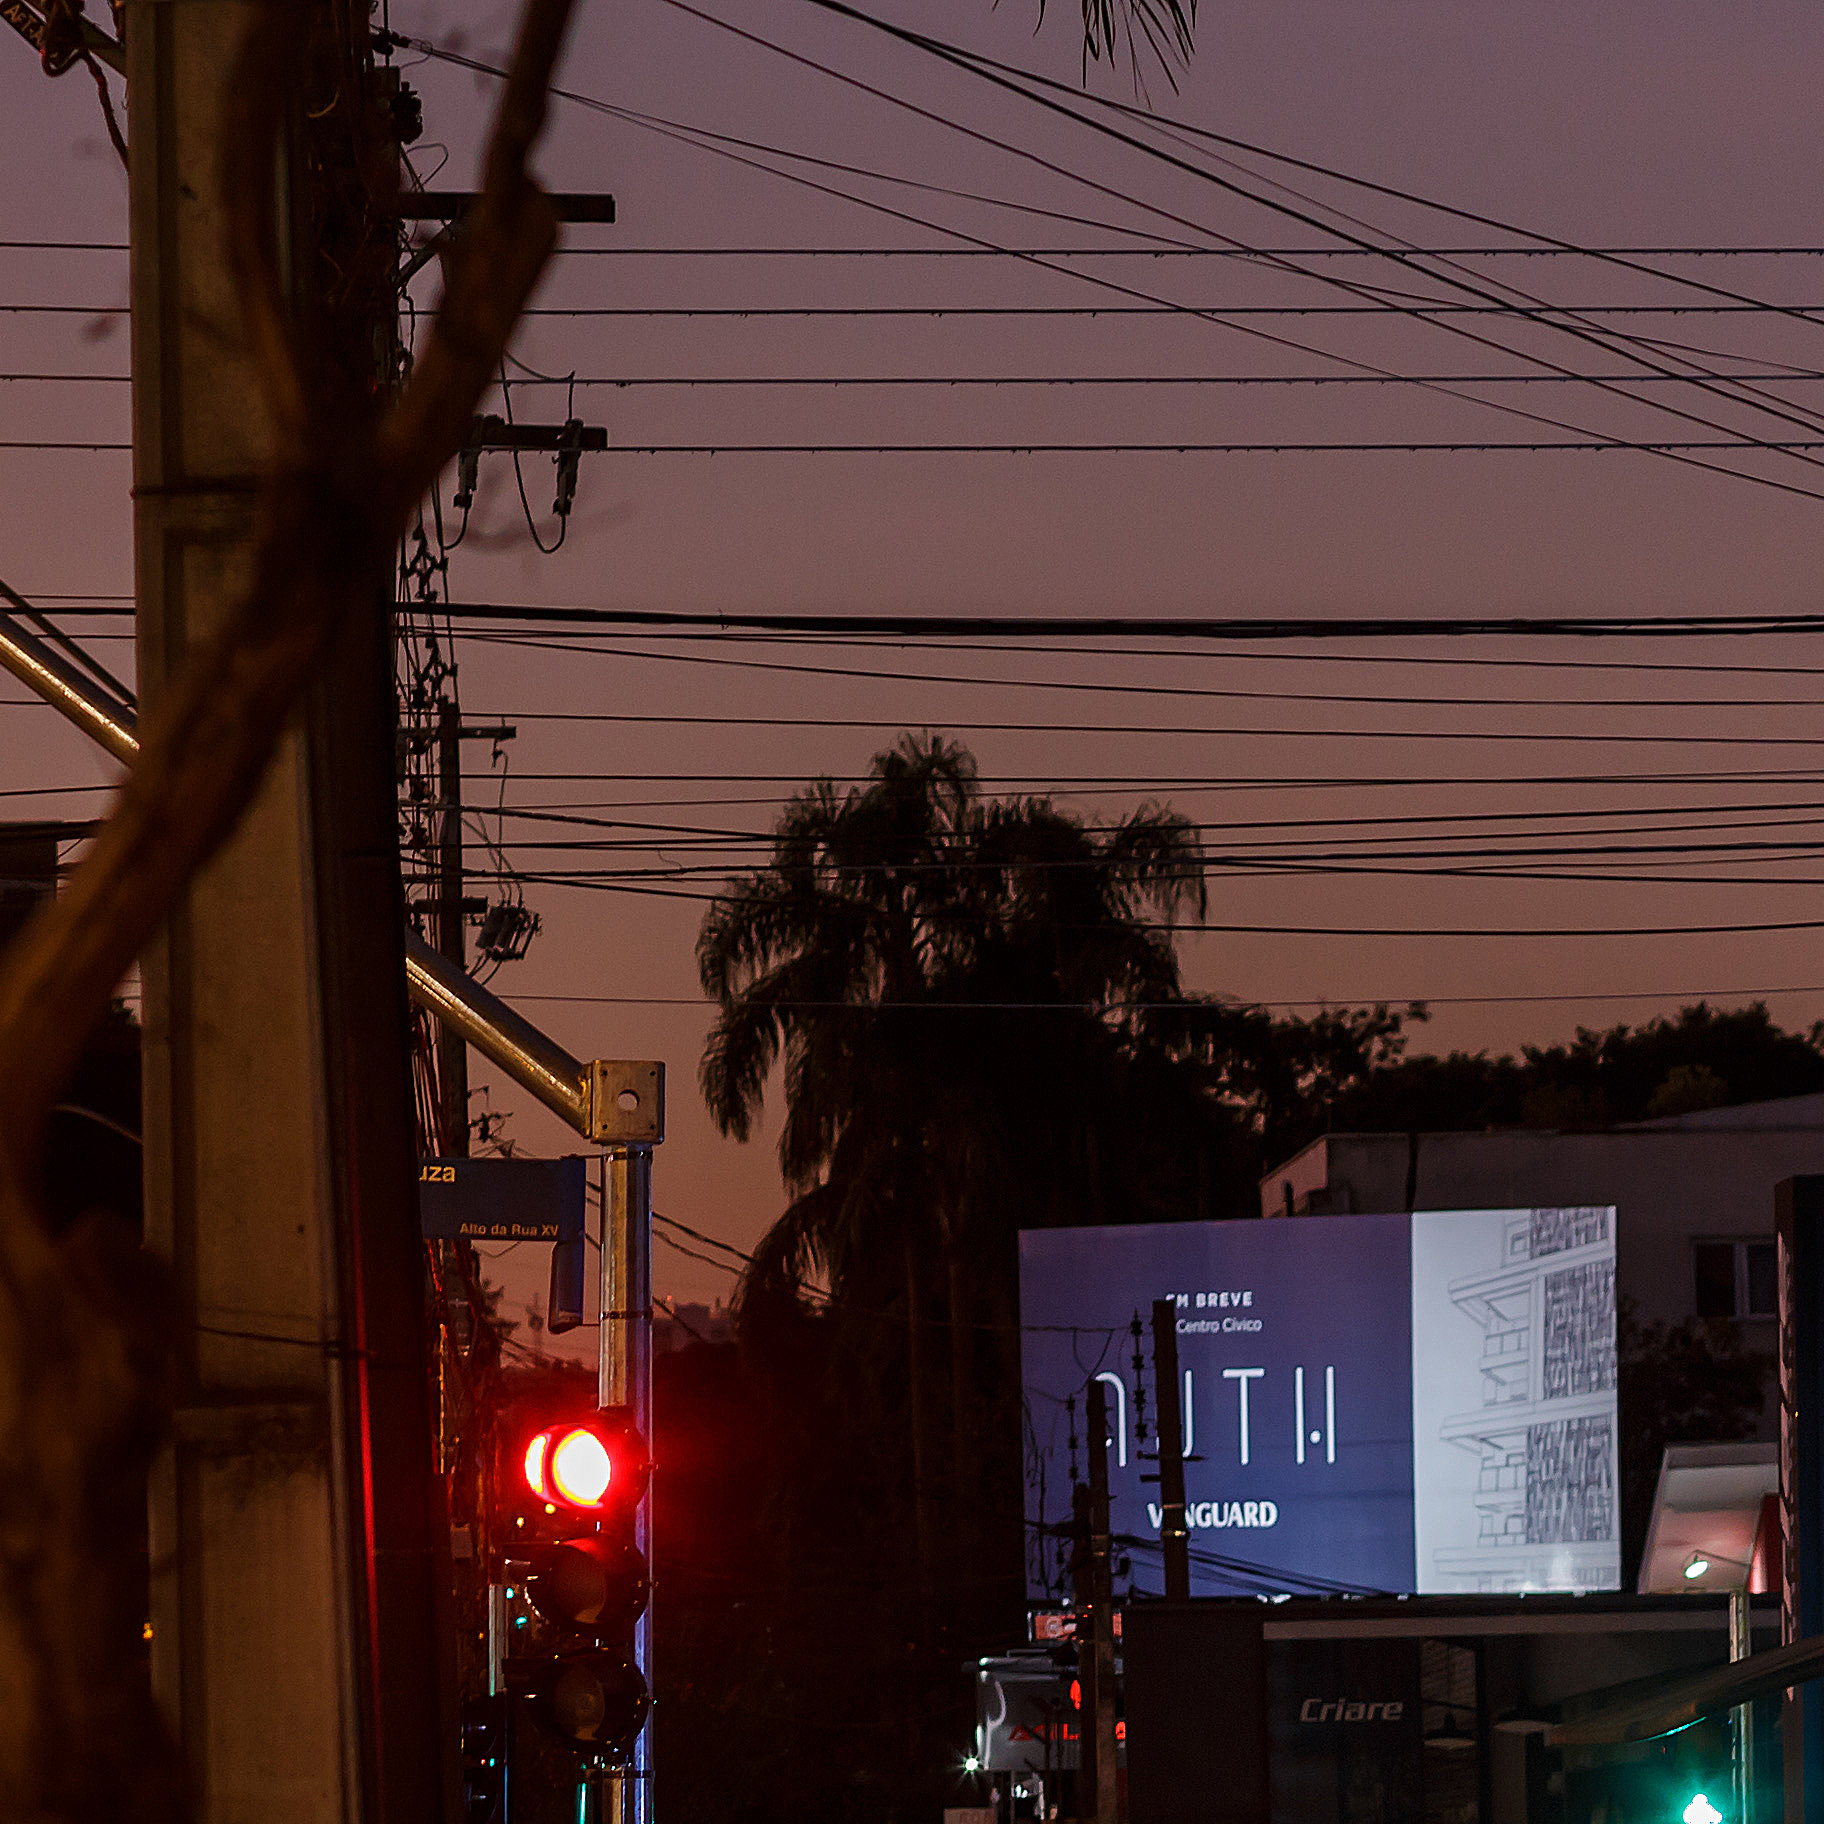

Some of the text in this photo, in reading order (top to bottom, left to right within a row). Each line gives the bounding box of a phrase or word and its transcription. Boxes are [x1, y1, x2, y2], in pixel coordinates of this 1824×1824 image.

[459, 1223, 559, 1236] Alto da Rua XV
[1196, 1291, 1253, 1308] BREVE
[1176, 1319, 1220, 1334] Centro
[1147, 1500, 1278, 1529] VNGUARD
[1300, 1697, 1403, 1722] Criare
